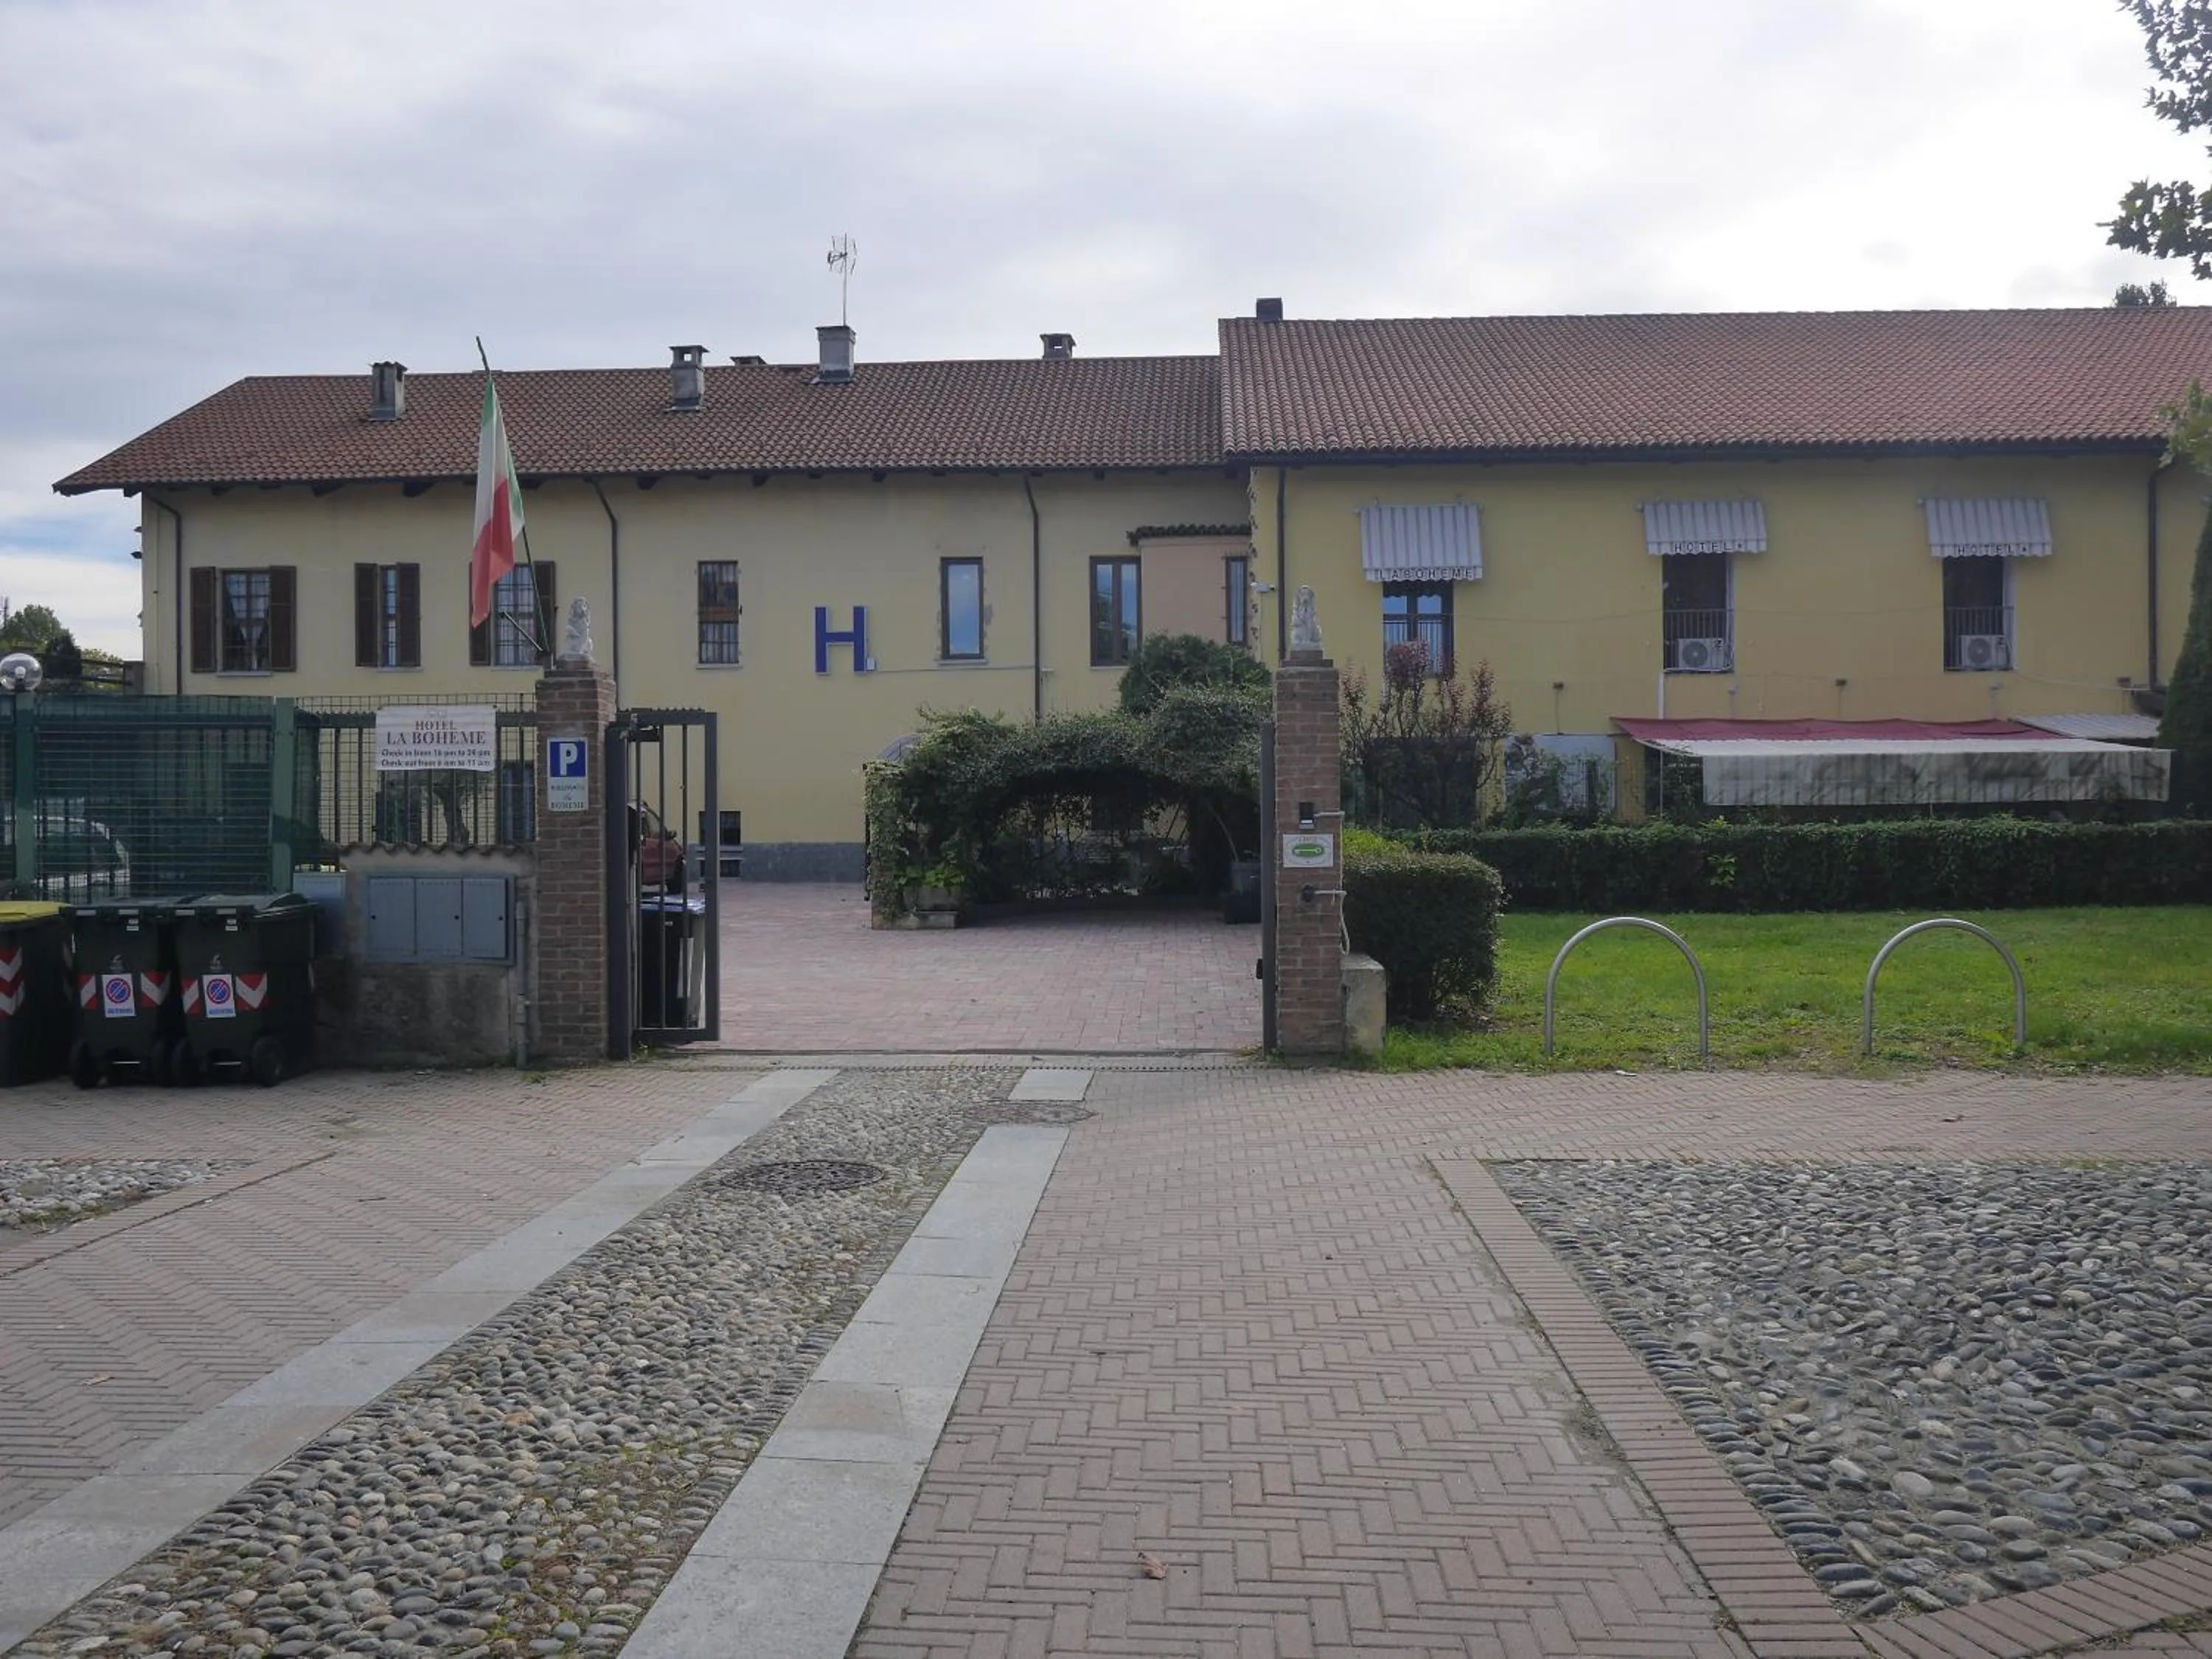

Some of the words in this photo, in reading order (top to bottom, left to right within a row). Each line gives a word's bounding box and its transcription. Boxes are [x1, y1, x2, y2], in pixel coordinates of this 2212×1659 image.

[1674, 542, 1731, 552] HOTEL
[1958, 544, 2014, 554] HOTEL
[815, 605, 866, 673] H
[415, 719, 457, 731] HOTEL
[387, 731, 407, 745] LA
[412, 731, 486, 745] BOHEME
[381, 748, 403, 757] Check
[560, 742, 578, 776] P
